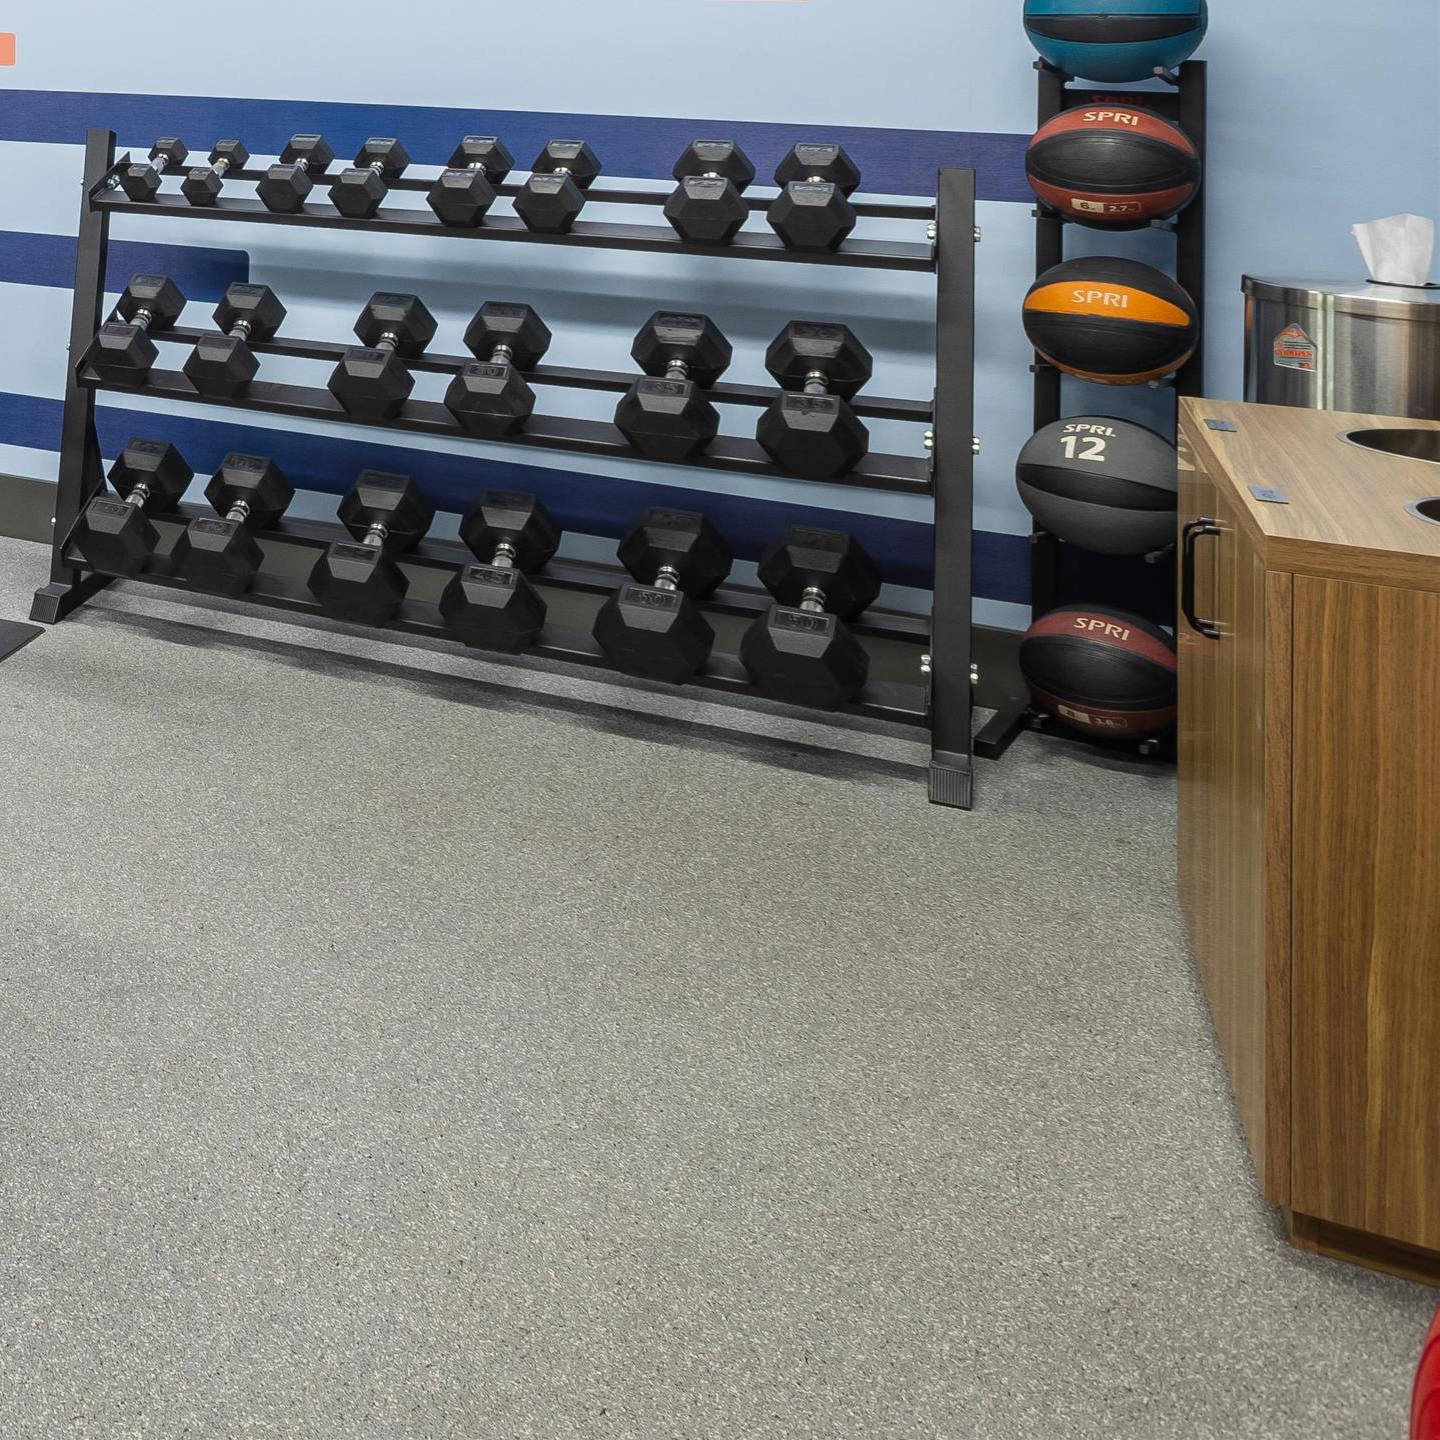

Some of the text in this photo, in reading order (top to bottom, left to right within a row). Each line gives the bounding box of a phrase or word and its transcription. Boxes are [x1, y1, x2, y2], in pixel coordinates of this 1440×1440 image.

[1082, 111, 1140, 126] SPRI
[1072, 289, 1128, 308] SPRI
[1063, 423, 1114, 437] SPRI
[1060, 435, 1107, 462] 12
[1073, 617, 1130, 641] SPRI
